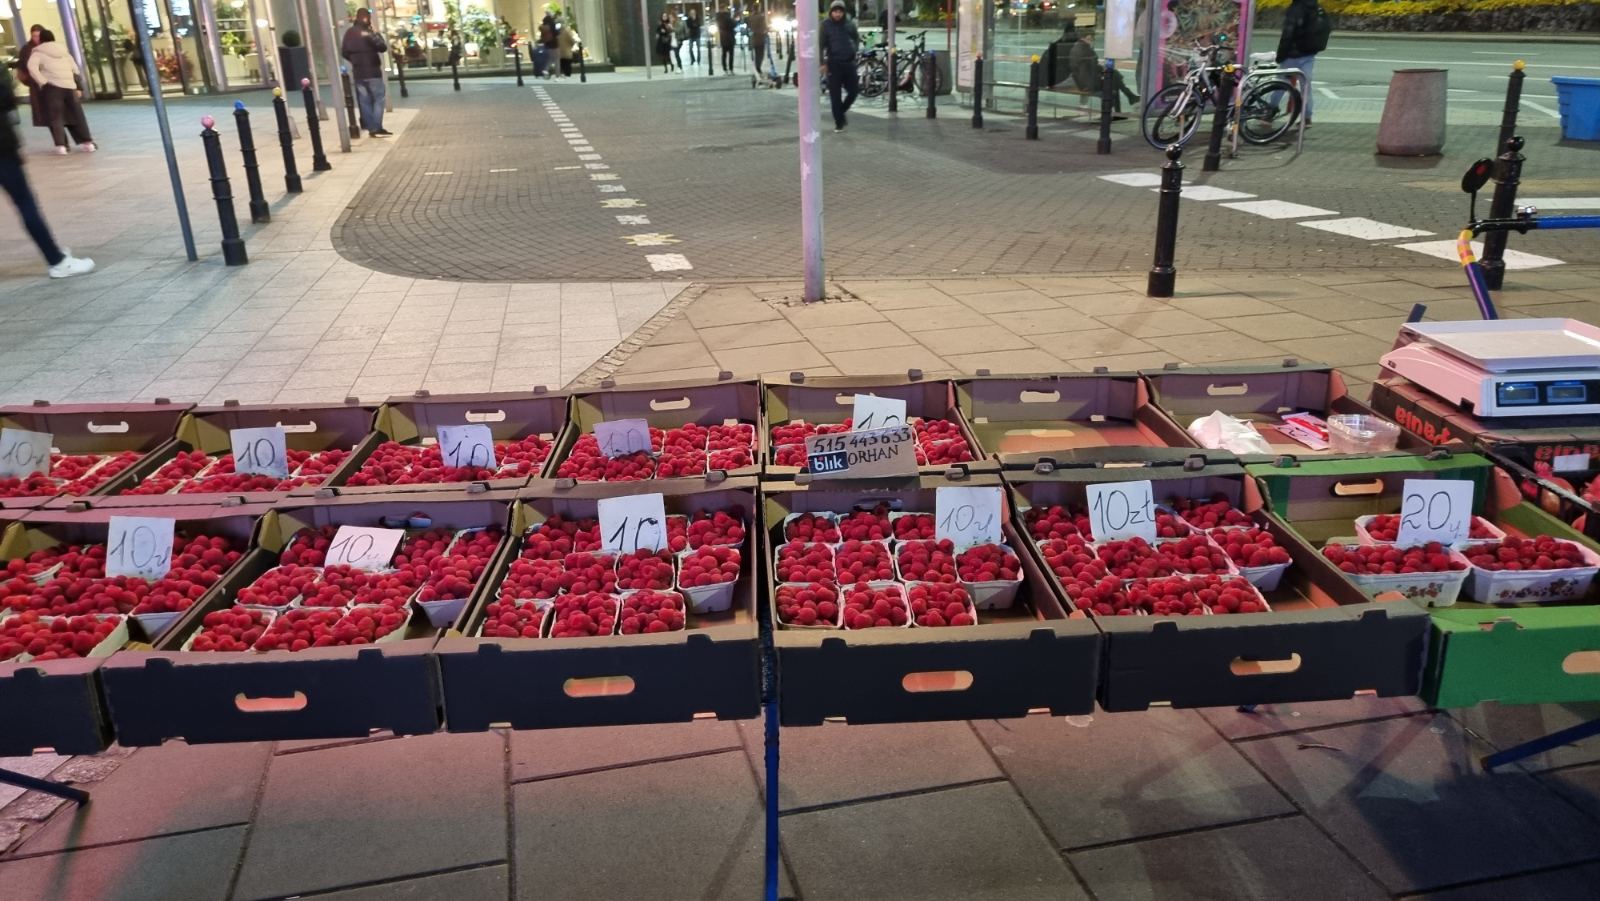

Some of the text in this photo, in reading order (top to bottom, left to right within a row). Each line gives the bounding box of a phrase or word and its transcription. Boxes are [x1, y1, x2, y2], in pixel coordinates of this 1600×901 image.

[237, 438, 276, 468] 10
[448, 440, 490, 469] 10
[814, 435, 847, 453] 515
[848, 444, 898, 466] ORHAN
[814, 456, 843, 471] blik
